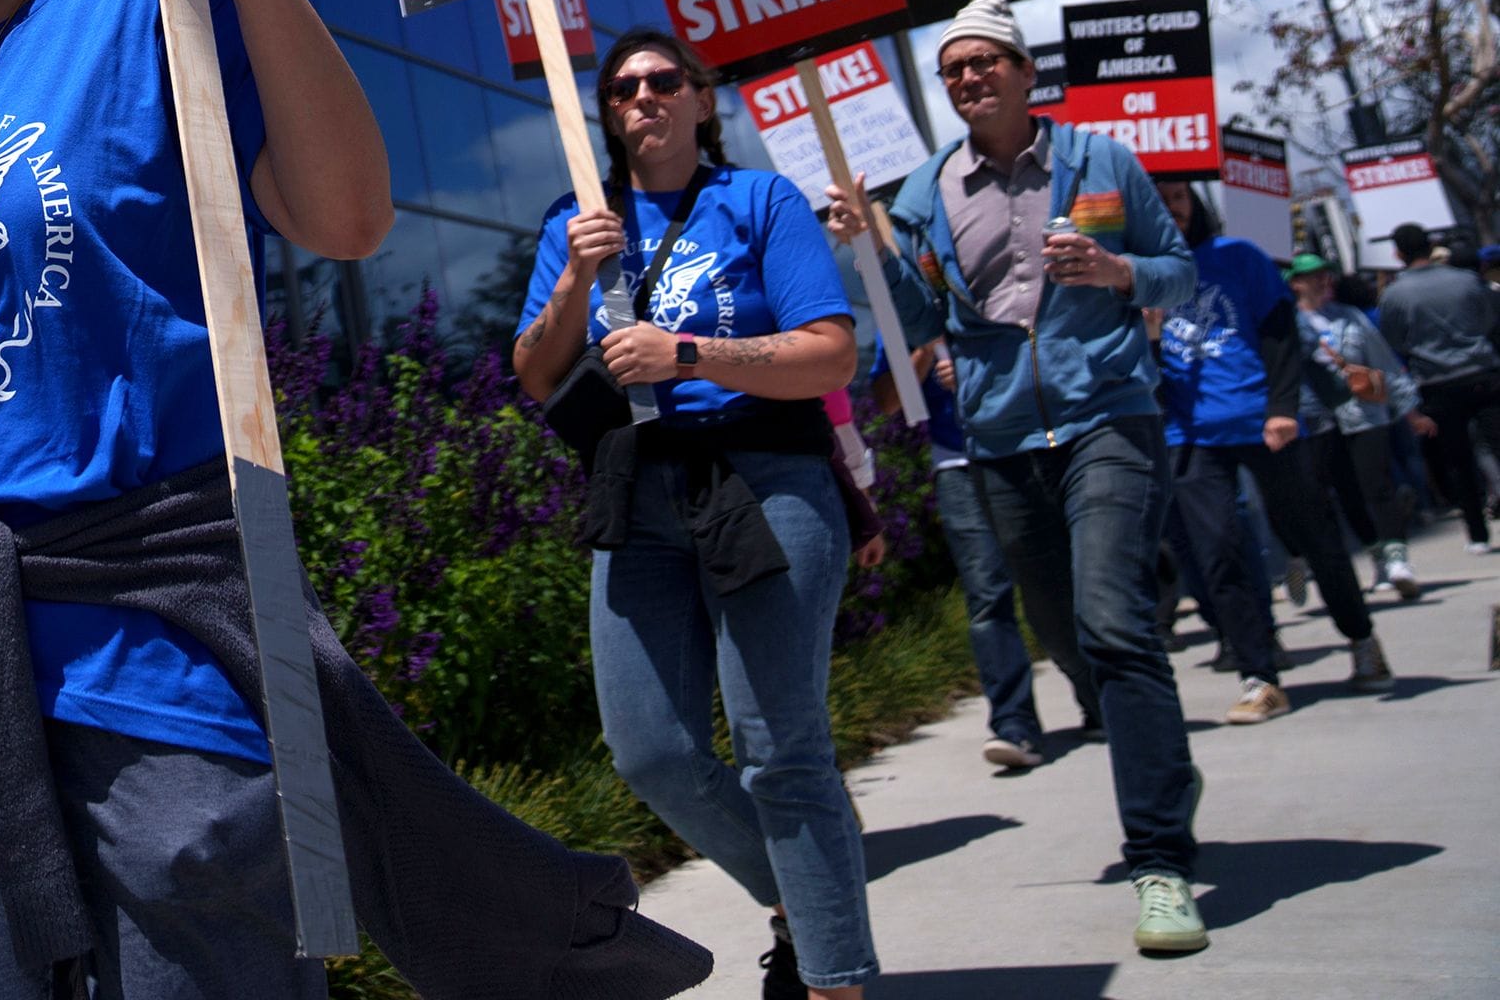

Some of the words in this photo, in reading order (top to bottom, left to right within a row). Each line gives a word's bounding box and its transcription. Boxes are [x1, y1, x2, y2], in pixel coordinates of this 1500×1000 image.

[1069, 15, 1146, 39] WRITERS
[1147, 10, 1201, 32] GUILD
[1097, 54, 1177, 79] AMERICA
[753, 48, 879, 122] STKE!
[1122, 92, 1157, 114] ON
[27, 150, 74, 309] AMERICA
[672, 238, 700, 256] OF
